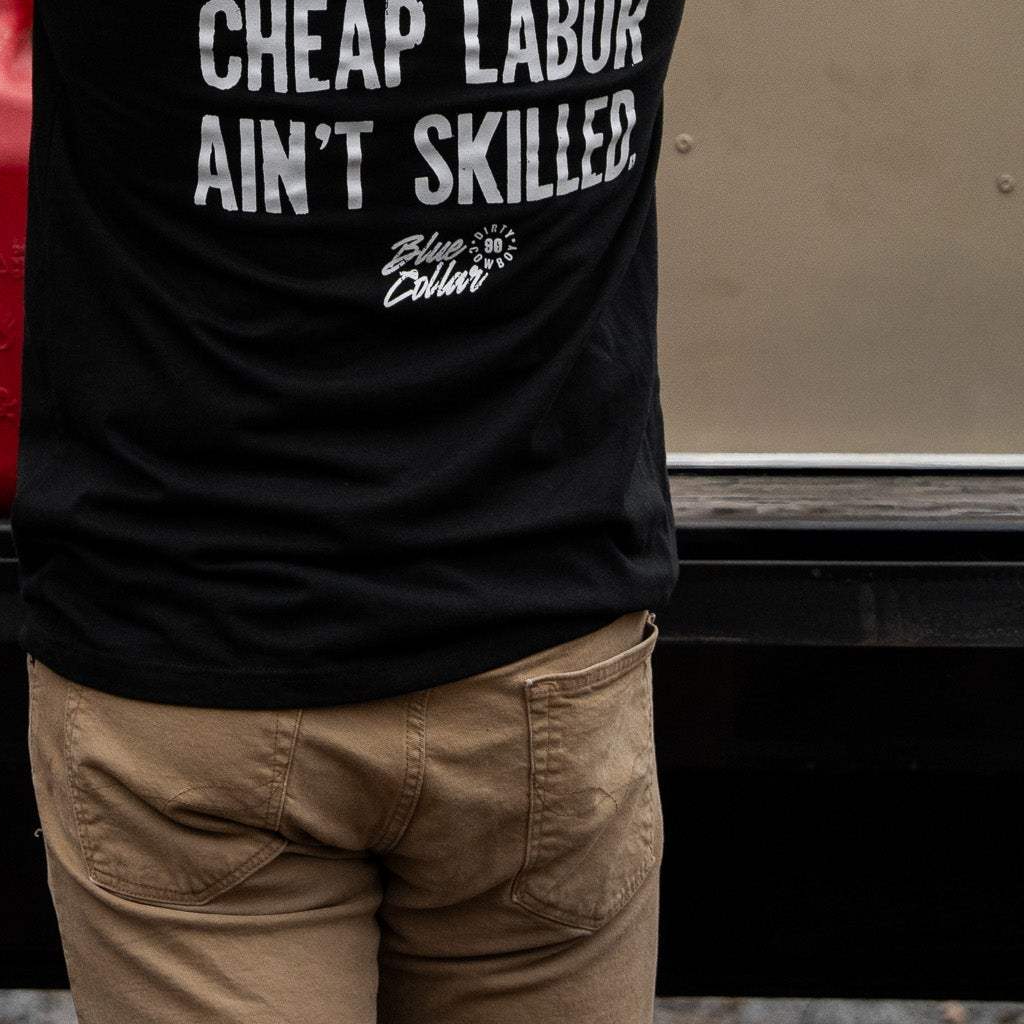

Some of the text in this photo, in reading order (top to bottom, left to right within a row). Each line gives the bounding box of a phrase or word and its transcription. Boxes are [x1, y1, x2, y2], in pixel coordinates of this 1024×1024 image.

[193, 89, 637, 216] AIN’T SKILLED.
[381, 231, 468, 276] Blue
[474, 223, 515, 241] DIRTY
[468, 245, 518, 270] COWBOY
[383, 259, 489, 308] Collar
